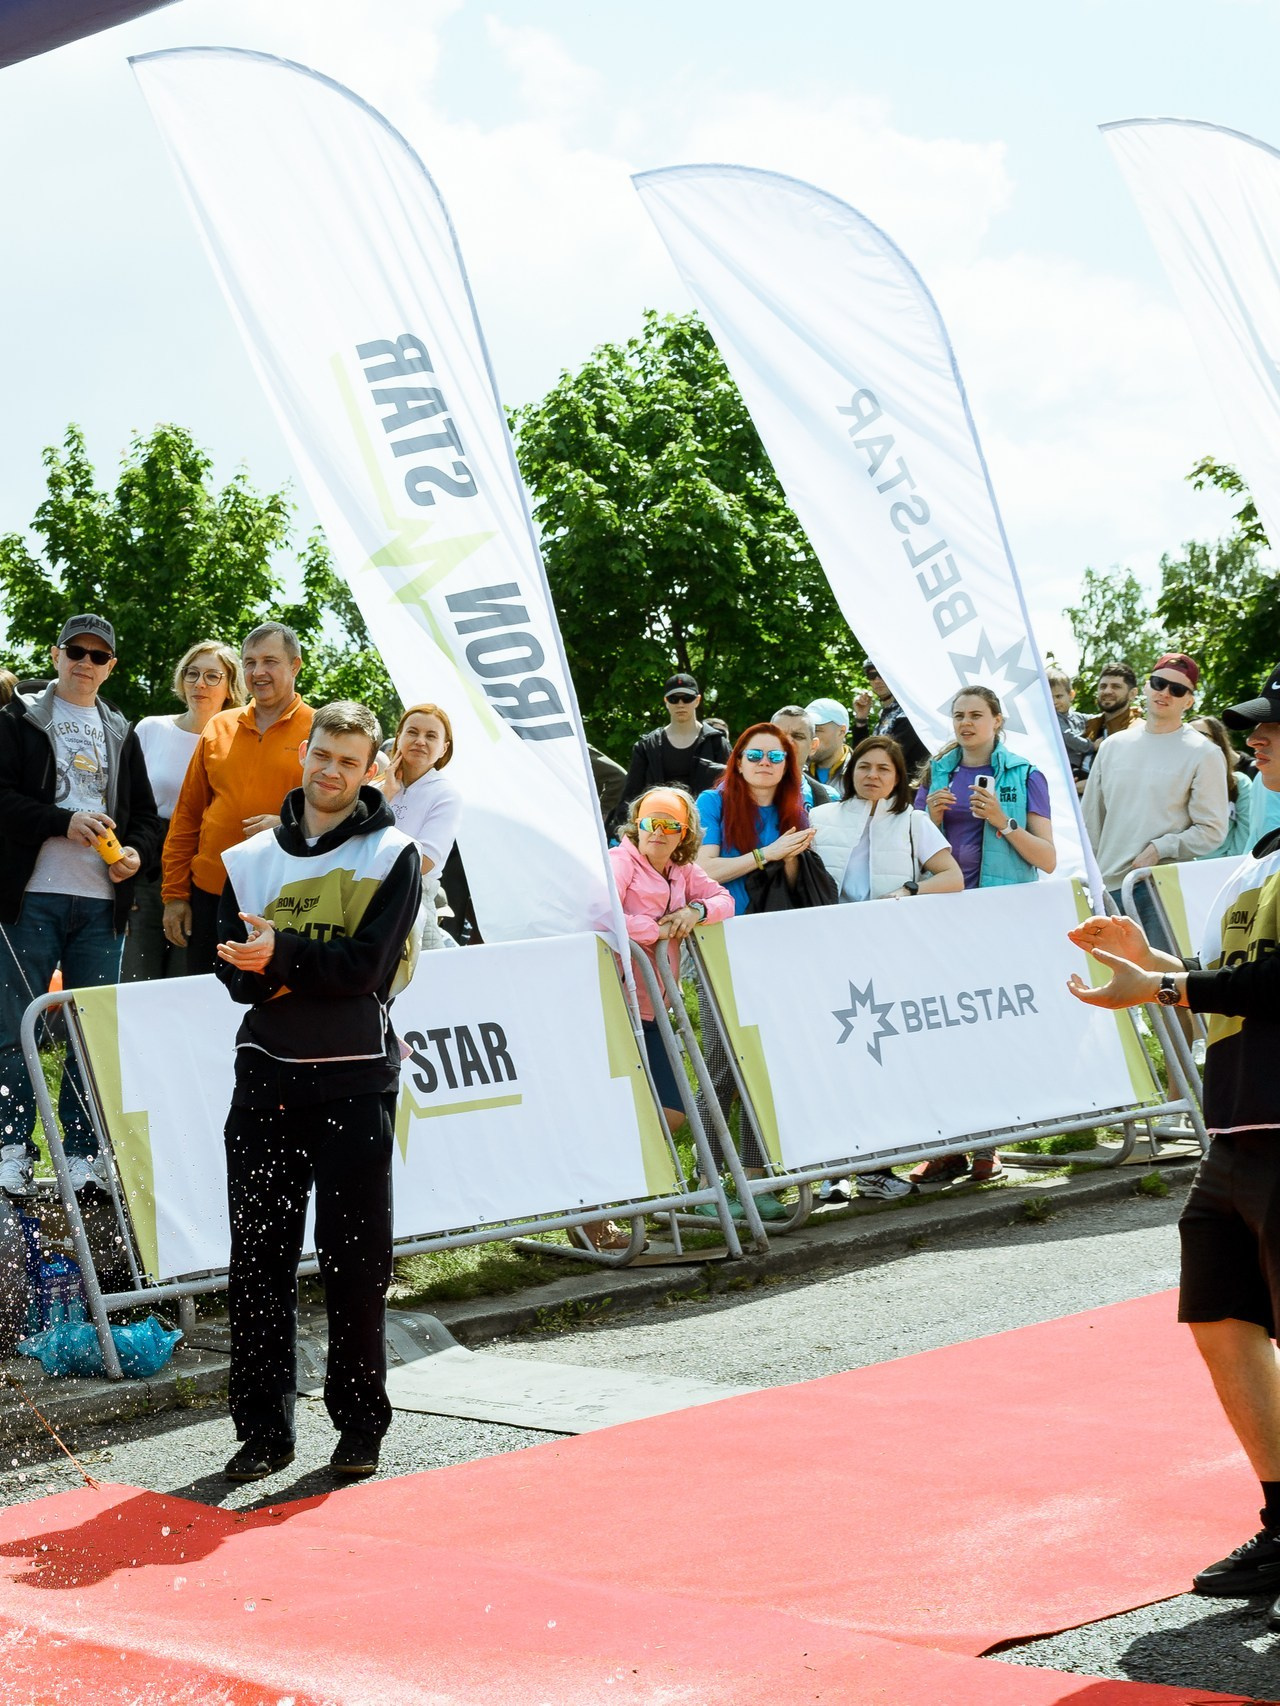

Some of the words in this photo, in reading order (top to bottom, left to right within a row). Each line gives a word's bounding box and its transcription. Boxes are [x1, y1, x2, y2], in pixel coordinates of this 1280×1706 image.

[84, 724, 105, 743] GAR
[900, 983, 1039, 1033] BELSTAR
[403, 1022, 518, 1094] STAR
